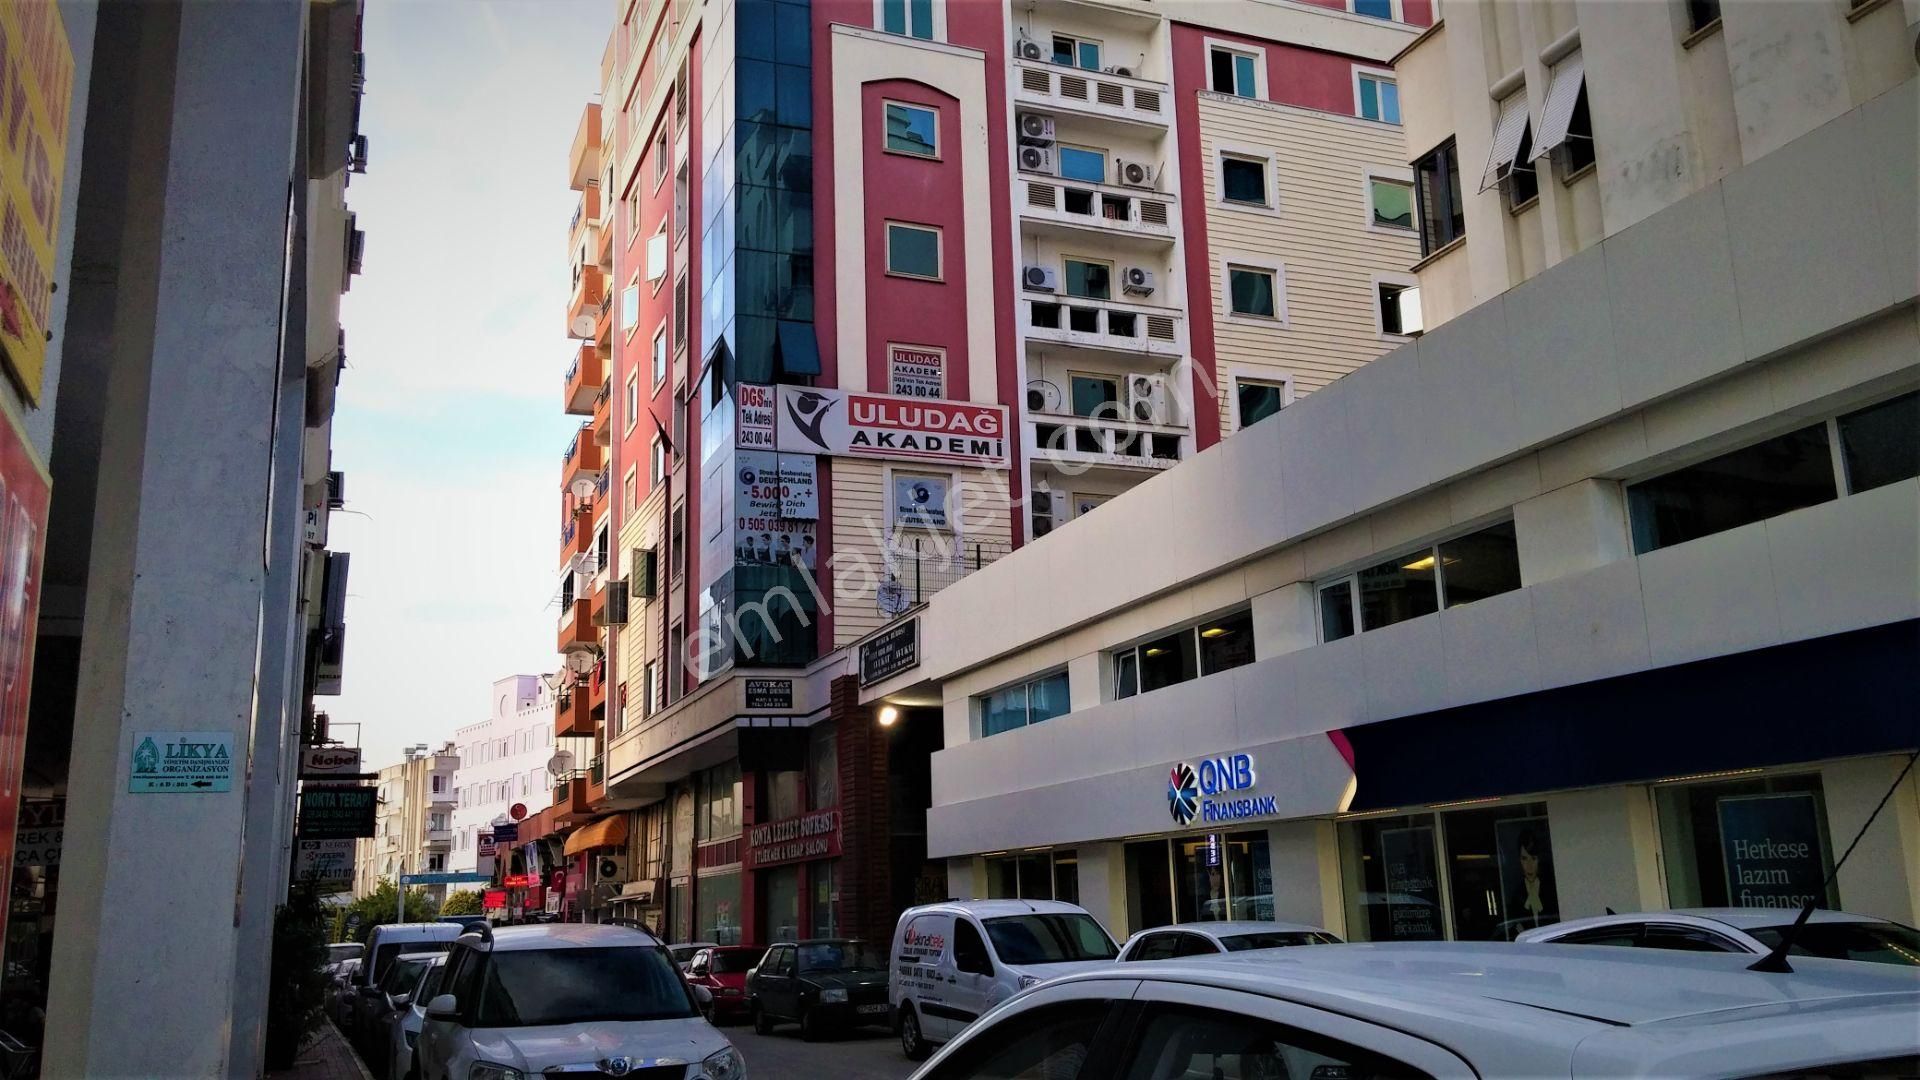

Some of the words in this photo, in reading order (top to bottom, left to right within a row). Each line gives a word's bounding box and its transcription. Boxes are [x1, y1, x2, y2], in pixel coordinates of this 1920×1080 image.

[896, 384, 912, 396] 243
[915, 386, 926, 397] 00
[929, 387, 940, 398] 44
[742, 409, 752, 424] Tek
[754, 410, 772, 426] Adresi
[853, 401, 998, 434] ULUDAĞ
[742, 430, 753, 444] 243
[755, 431, 763, 444] 00
[764, 432, 772, 445] 44
[851, 430, 1003, 457] AKADEMİ
[759, 476, 813, 485] DEUTSCHLAND
[786, 500, 806, 508] Dich
[739, 517, 745, 530] 0
[748, 518, 765, 531] 505
[165, 741, 229, 759] LİKYA
[312, 755, 359, 765] Nobel
[162, 765, 229, 773] ORGANİZASYON
[1199, 754, 1255, 795] QNB
[304, 792, 336, 807] NOKTA
[750, 825, 772, 847] KONYA
[772, 819, 800, 844] LEZZET
[800, 811, 834, 838] SOFRASI
[1733, 838, 1809, 860] Herkese
[1737, 864, 1792, 886] lazım
